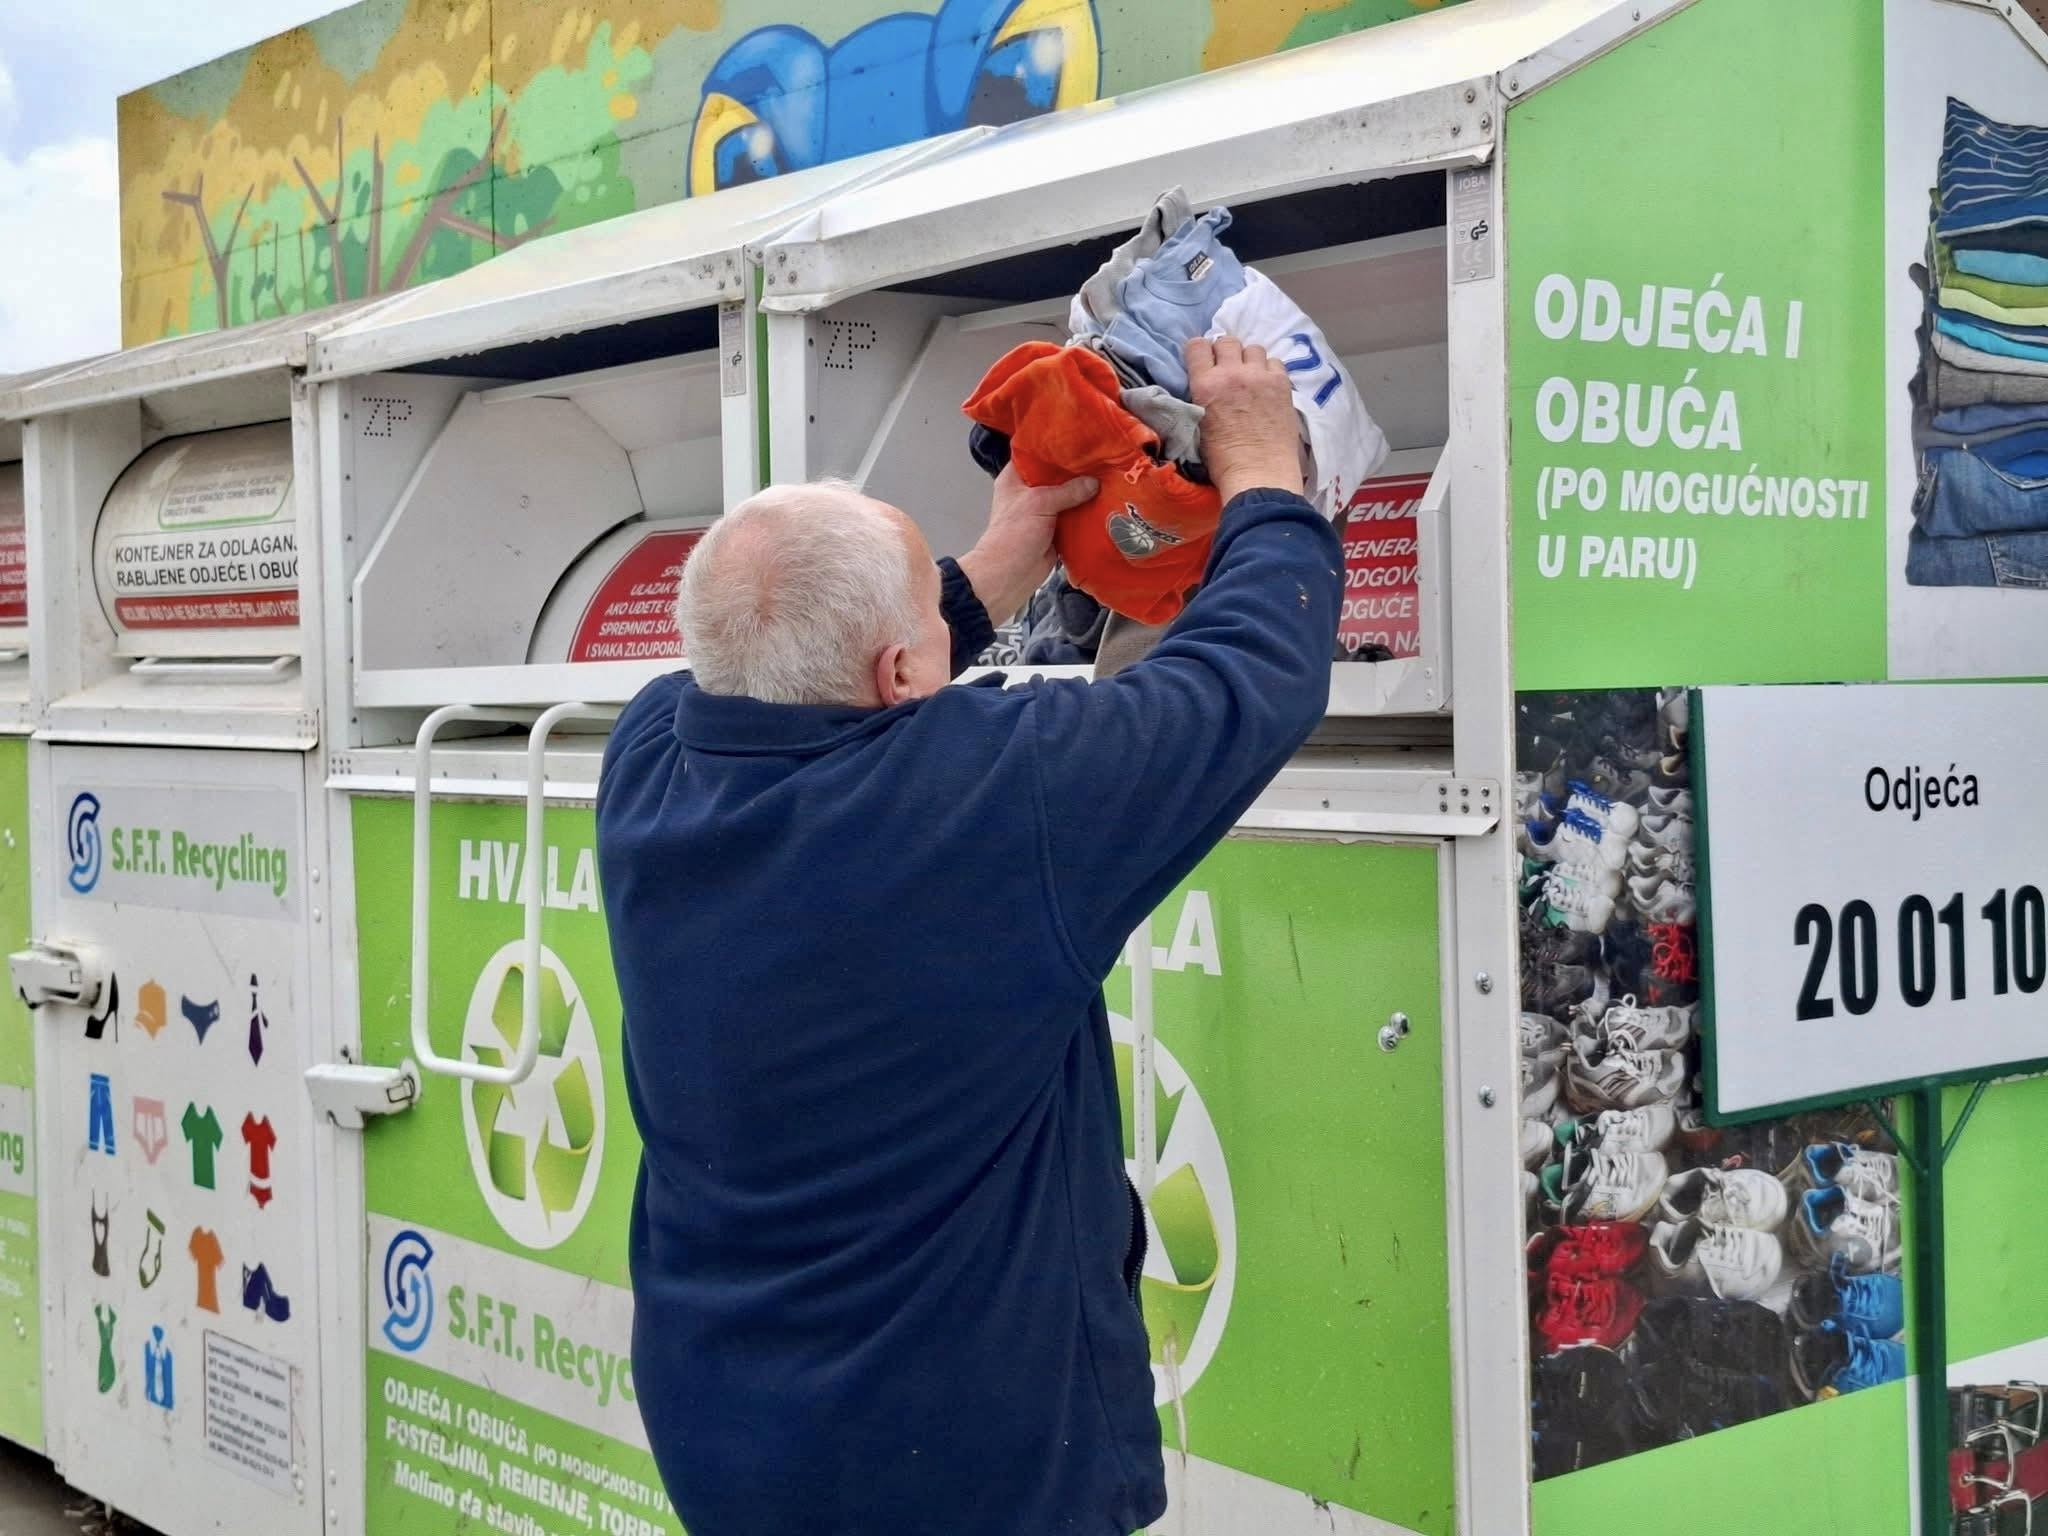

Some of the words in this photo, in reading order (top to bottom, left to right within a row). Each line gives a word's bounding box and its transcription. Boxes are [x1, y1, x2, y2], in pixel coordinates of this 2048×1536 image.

[823, 319, 876, 370] ZP
[1534, 272, 1767, 357] ODJEĆA
[1785, 300, 1802, 359] I
[362, 396, 412, 437] ZP
[1535, 368, 1742, 451] OBUĆA
[1536, 466, 1607, 520] (PO
[1620, 463, 1869, 519] MOGUĆNOSTI
[115, 543, 194, 563] KONTEJNER
[198, 542, 217, 559] ZA
[117, 567, 187, 586] RABLJENE
[190, 561, 248, 583] ODJEĆE
[250, 564, 256, 581] I
[1538, 534, 1566, 578] U
[1579, 535, 1697, 590] PARU)
[1340, 592, 1414, 620] OGUĆE
[1864, 763, 1979, 821] Odjeća
[111, 827, 166, 875] S.F.T.
[172, 831, 287, 897] Recycling
[1793, 899, 1879, 1021] 20
[1898, 892, 1967, 1007] 01
[1981, 885, 2046, 995] 10
[0, 1131, 24, 1175] ng
[448, 1284, 524, 1363] S.F.T.
[384, 1376, 451, 1425] ODJEĆA
[456, 1403, 463, 1428] I
[467, 1408, 529, 1457] OBUĆA
[534, 1442, 557, 1468] (PO
[560, 1452, 650, 1505] MOGUĆNOSTI
[653, 1490, 665, 1511] U
[385, 1415, 494, 1488] POSTELJINA,
[500, 1461, 593, 1529] REMENJE,
[394, 1460, 455, 1508] Molimo
[460, 1488, 482, 1520] da
